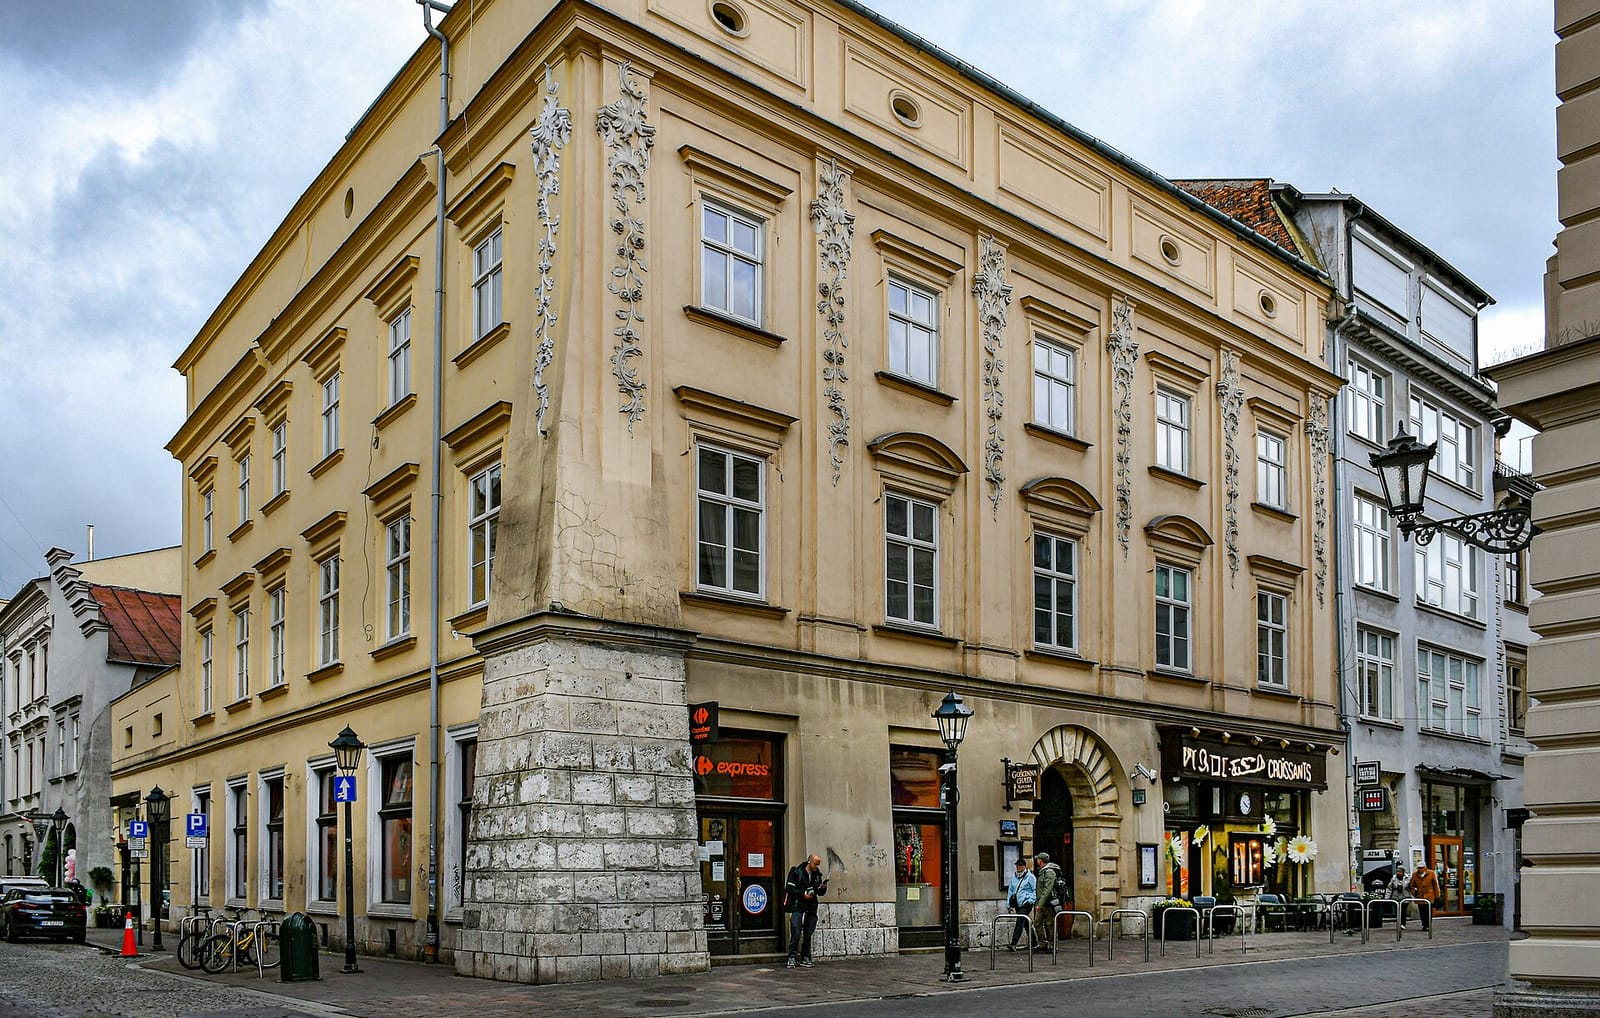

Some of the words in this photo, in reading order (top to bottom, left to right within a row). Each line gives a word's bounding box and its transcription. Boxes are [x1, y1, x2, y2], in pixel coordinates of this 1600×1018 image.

[717, 761, 769, 777] express
[134, 823, 144, 835] P
[191, 816, 203, 830] P
